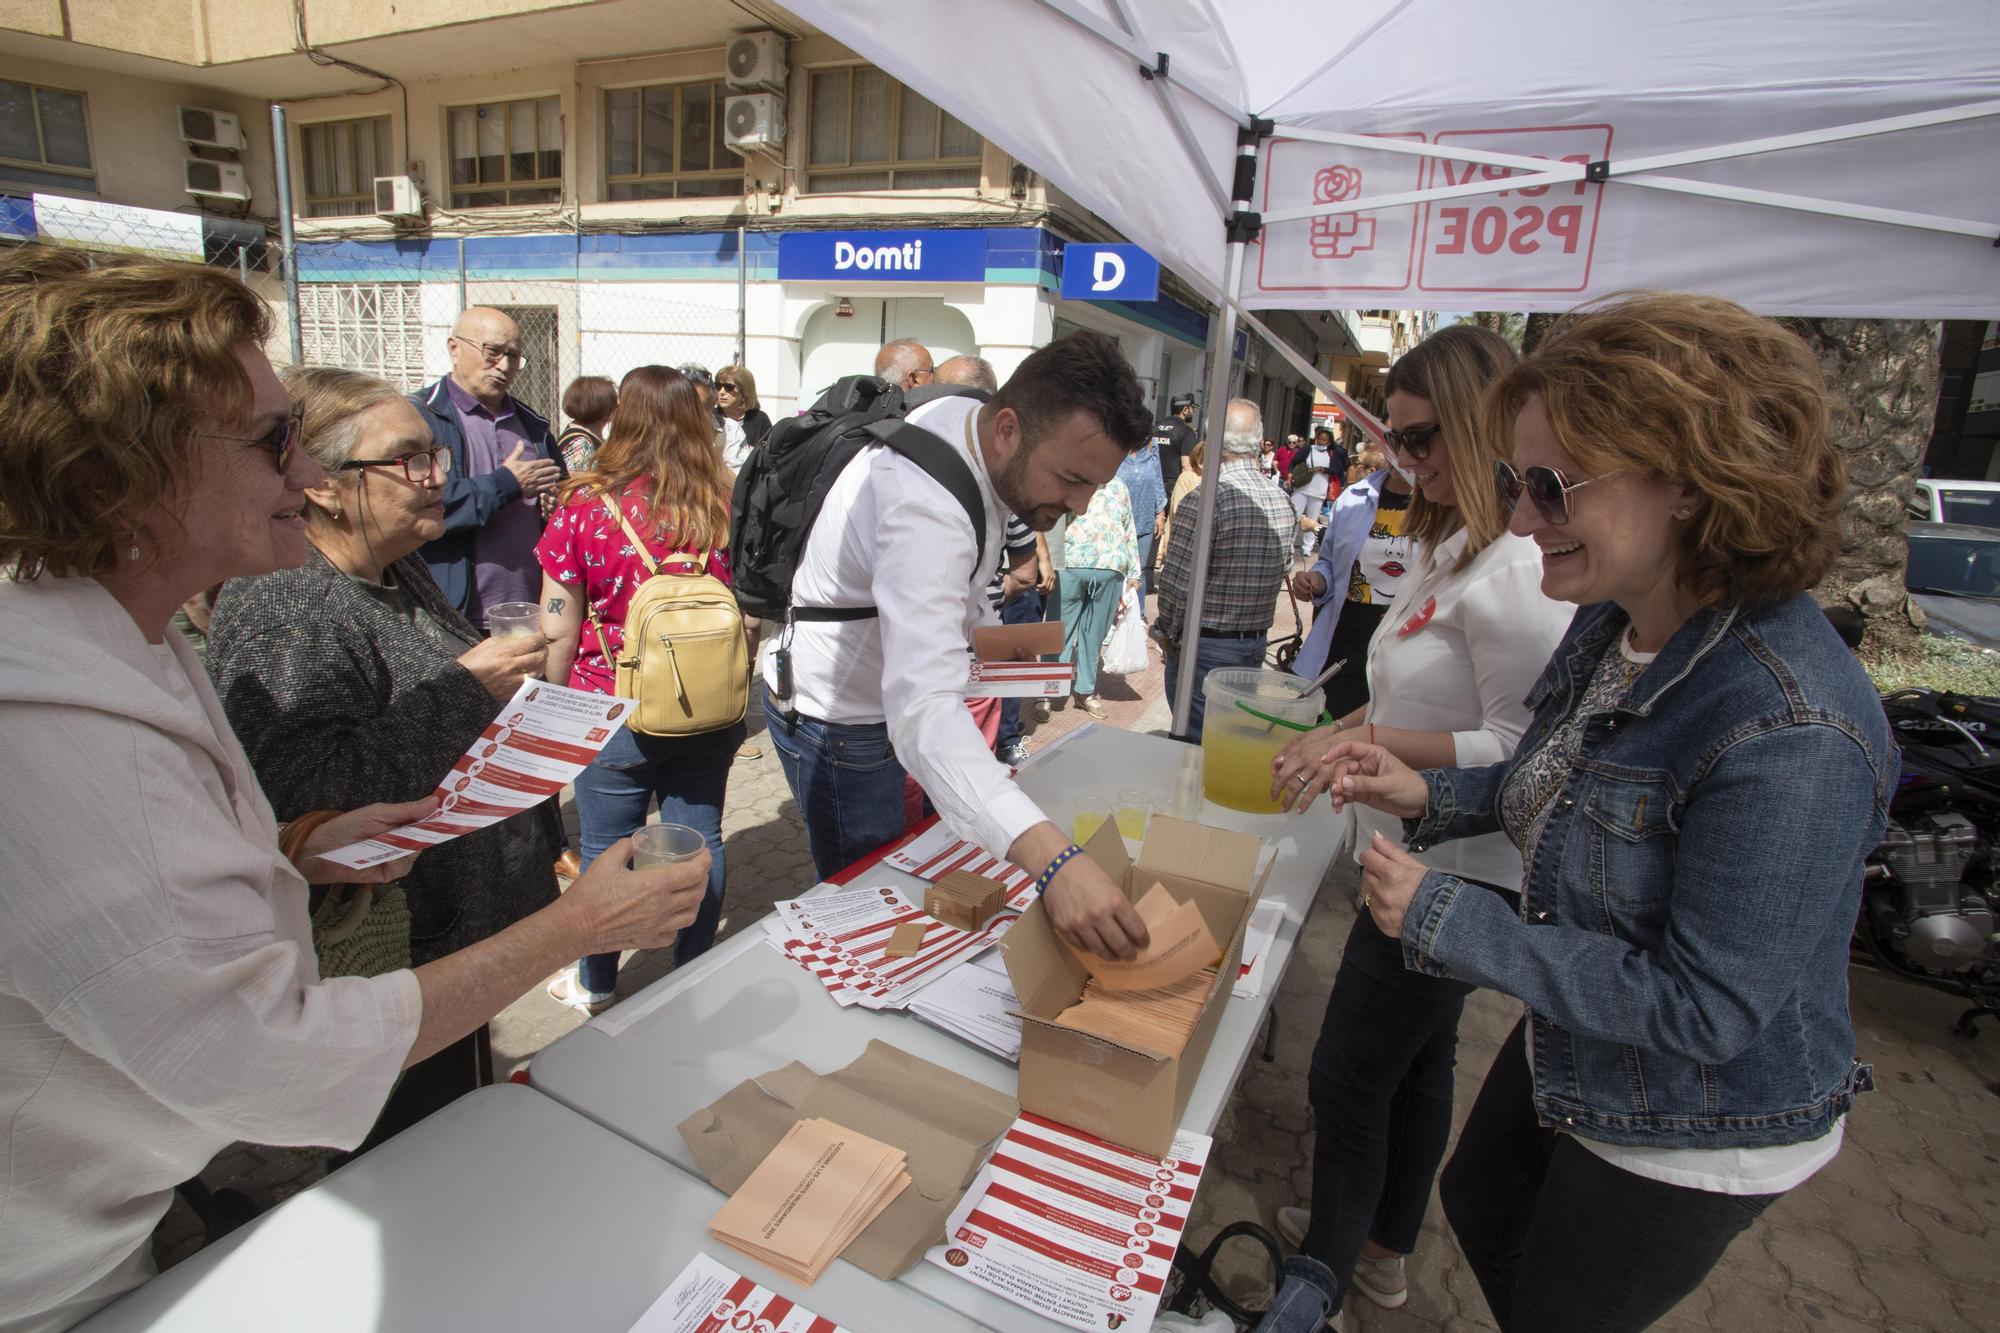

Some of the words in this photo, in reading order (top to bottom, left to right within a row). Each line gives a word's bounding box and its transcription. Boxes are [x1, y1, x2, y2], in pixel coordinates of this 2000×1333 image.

[834, 240, 922, 270] Domti
[1091, 252, 1126, 292] D
[1033, 1292, 1056, 1305] ENTRE
[1052, 1307, 1095, 1325] CONTRACTE
